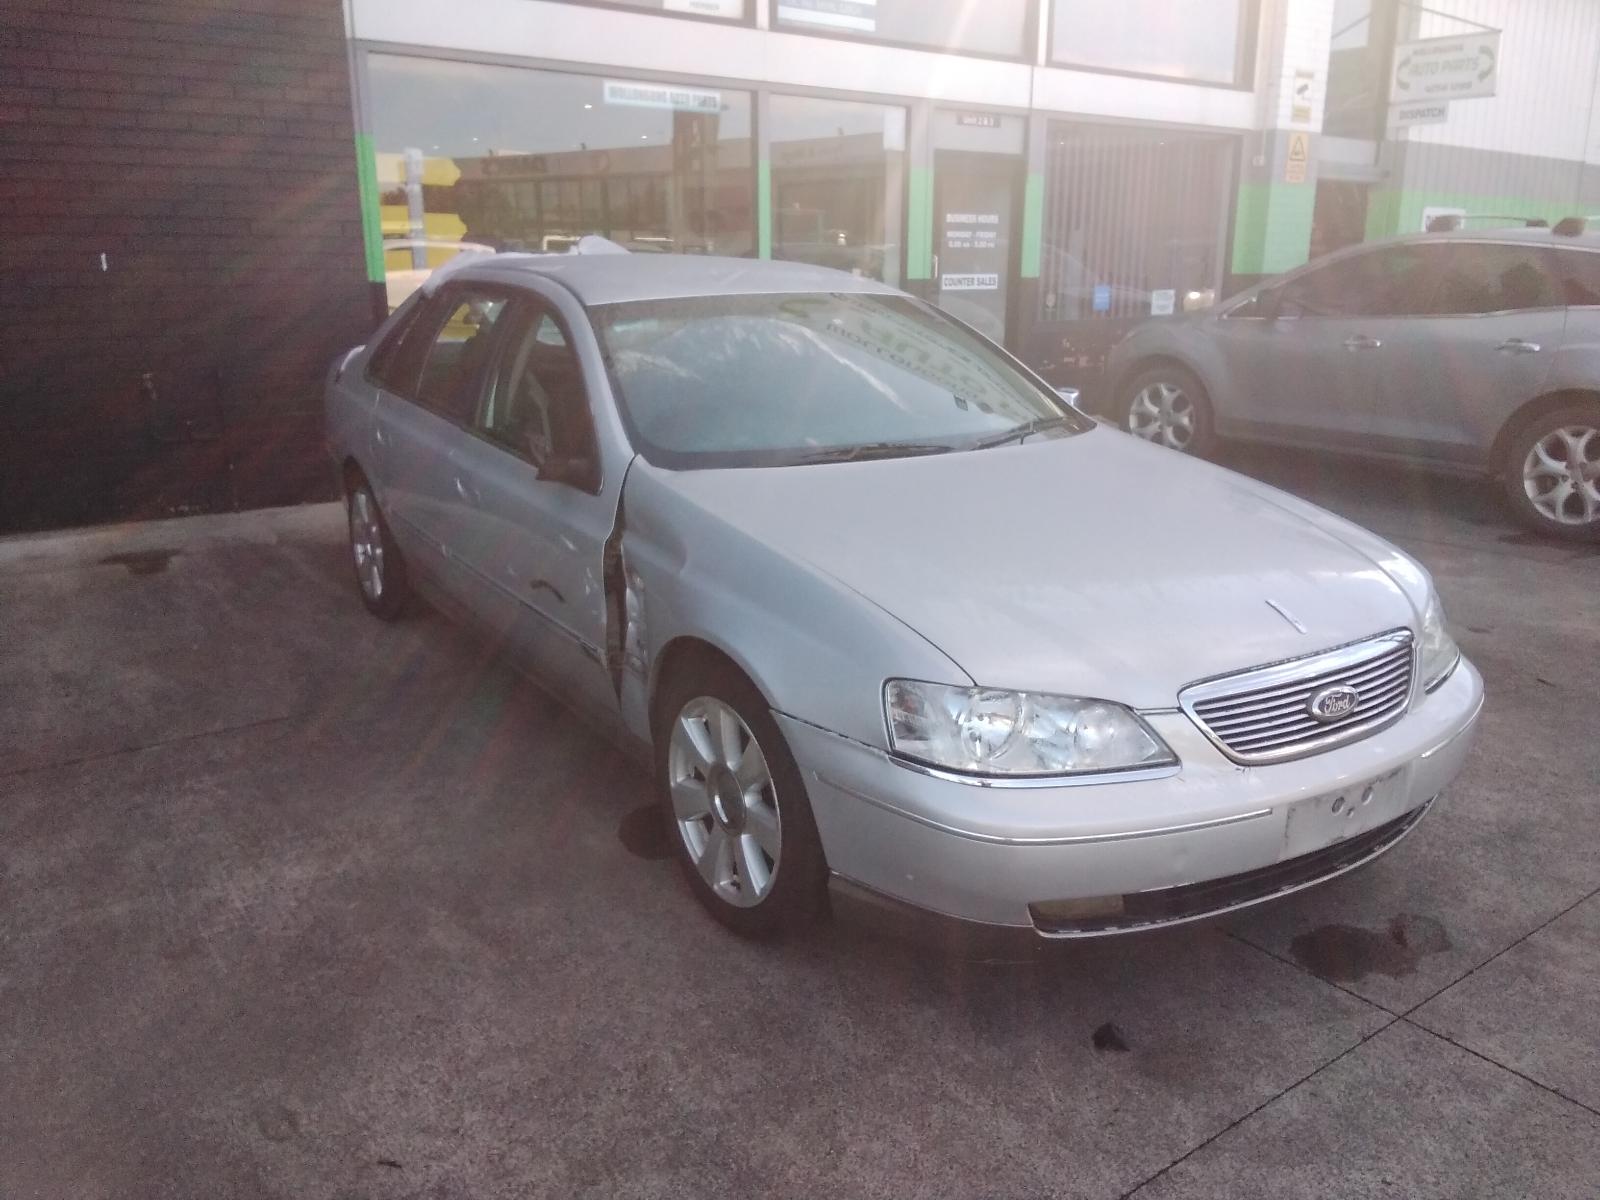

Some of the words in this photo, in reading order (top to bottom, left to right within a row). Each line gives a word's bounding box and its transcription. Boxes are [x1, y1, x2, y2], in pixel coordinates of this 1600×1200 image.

[1399, 106, 1446, 121] DISPATCH
[943, 277, 975, 287] COUNTER
[975, 276, 997, 287] SALES
[1324, 693, 1350, 714] Ford
